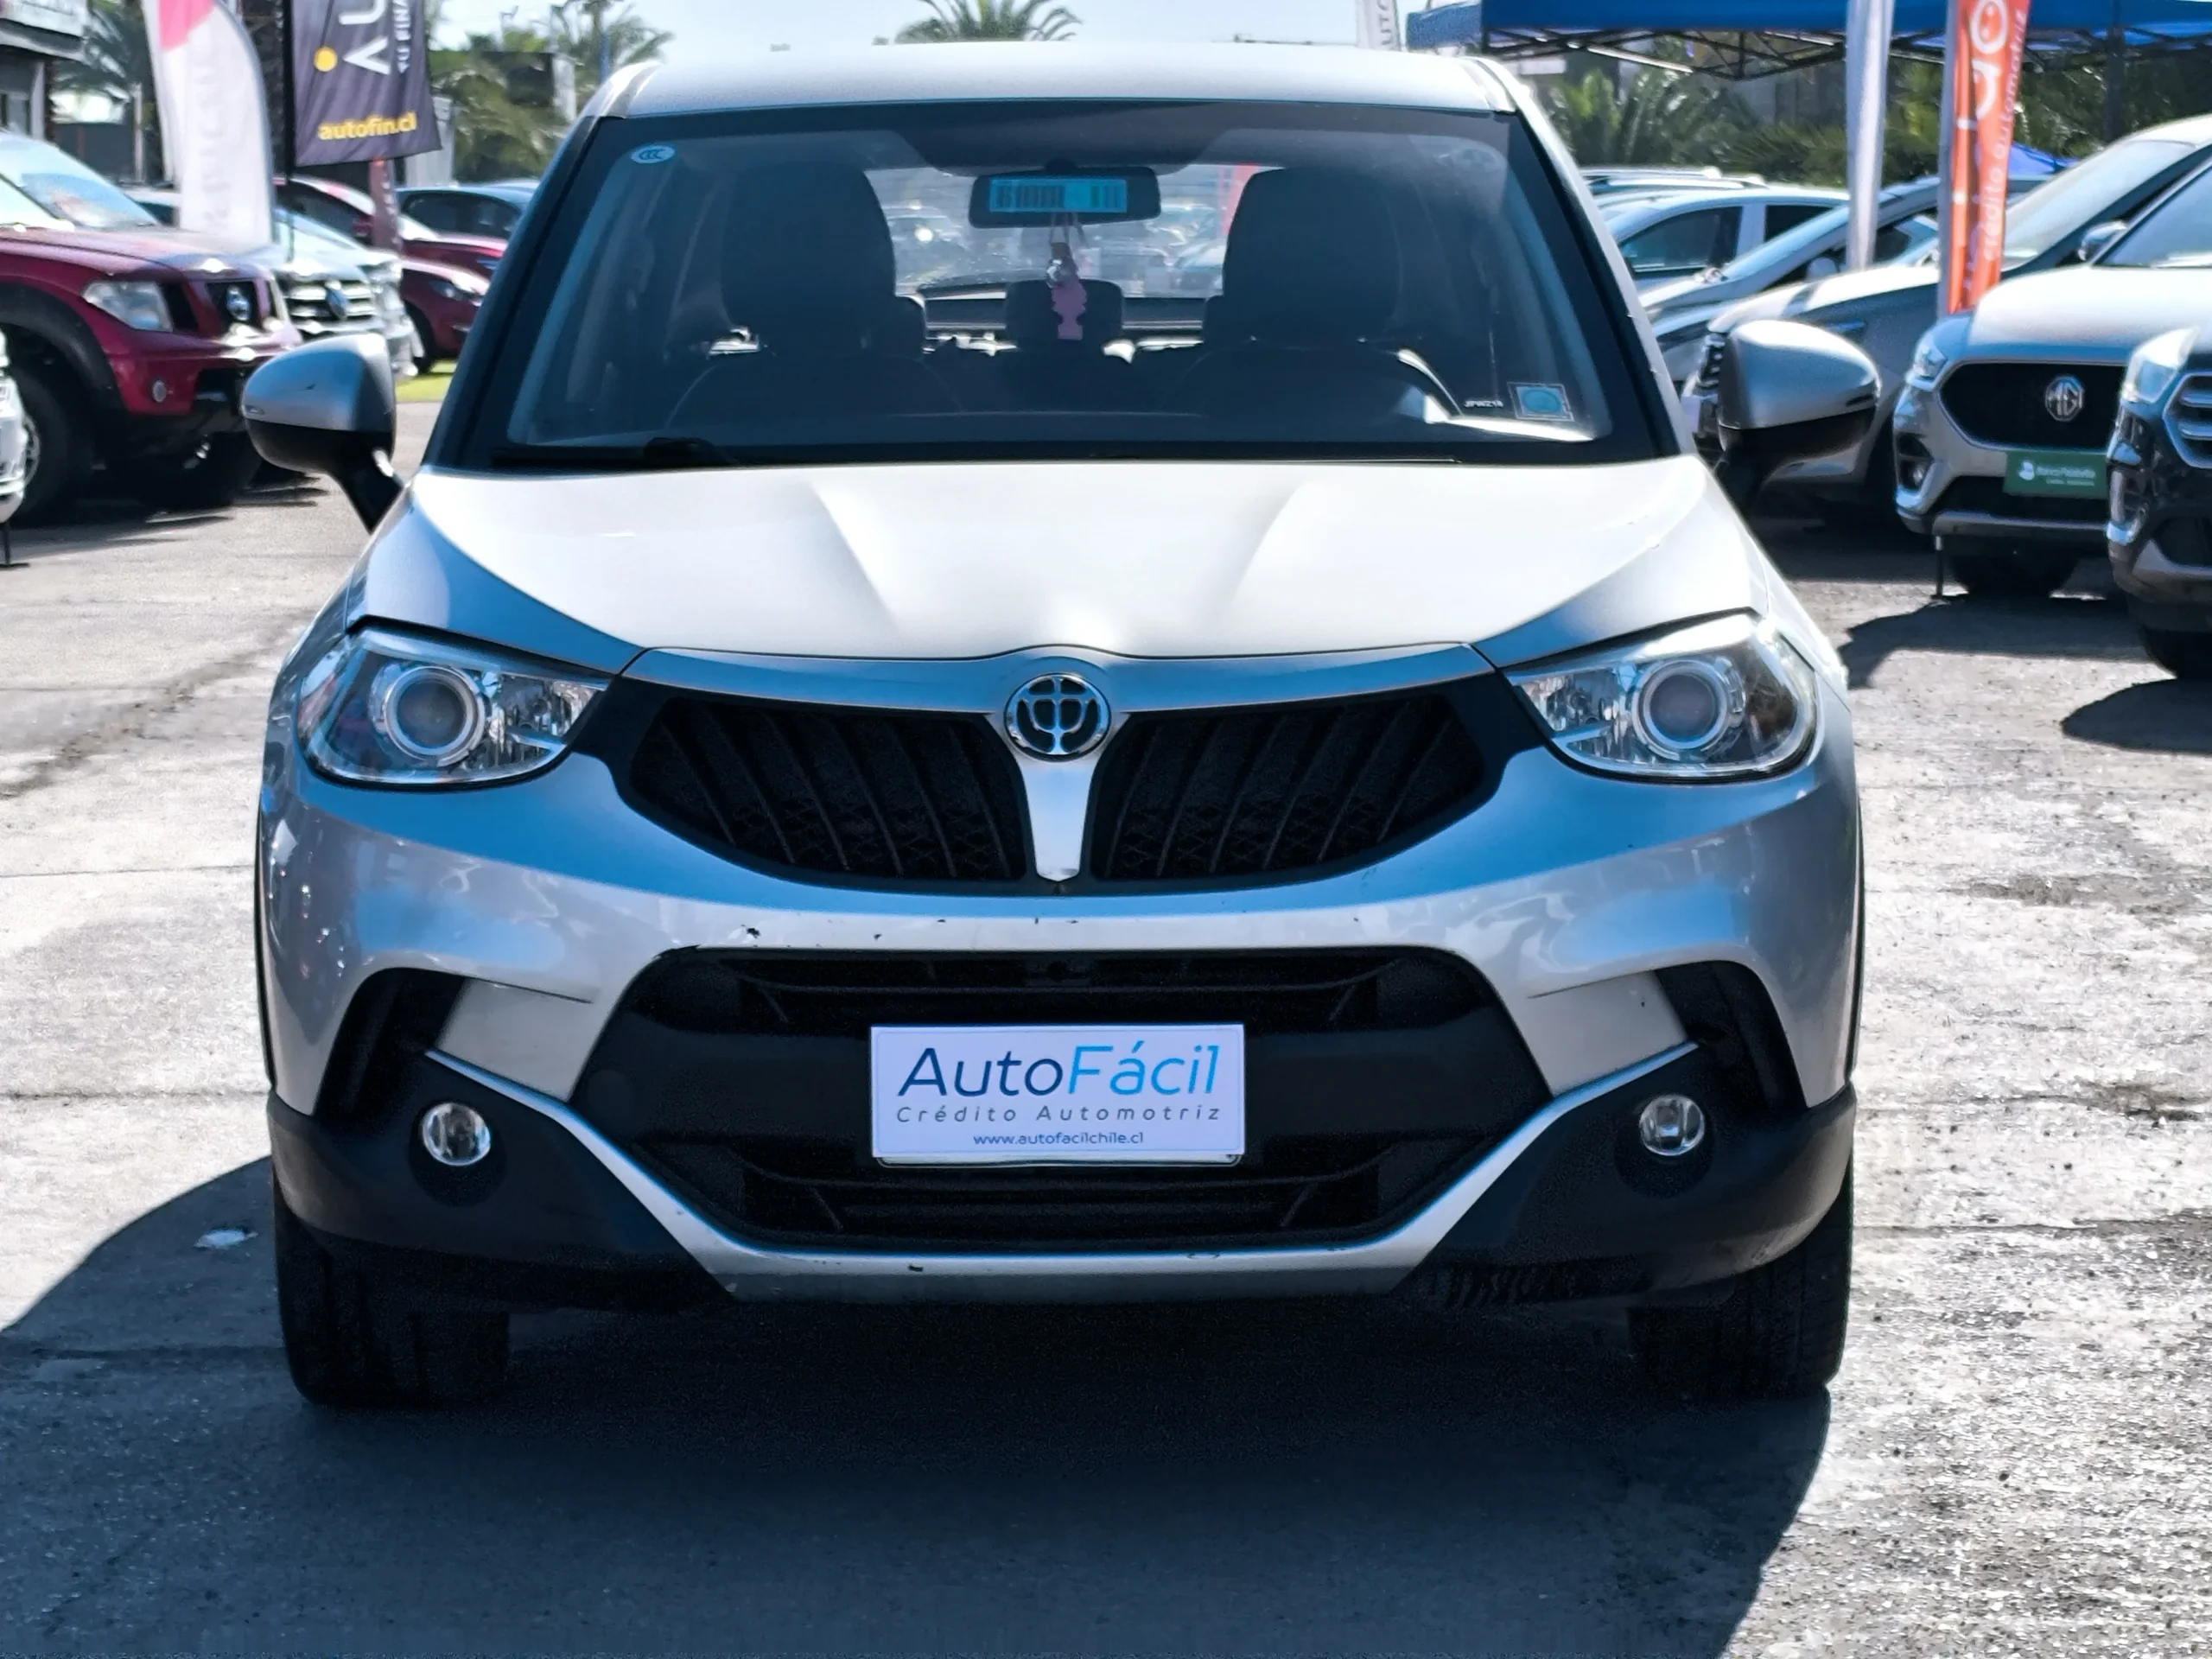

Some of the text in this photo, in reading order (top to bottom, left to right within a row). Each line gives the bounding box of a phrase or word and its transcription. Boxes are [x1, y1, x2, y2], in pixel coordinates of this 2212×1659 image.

[318, 111, 417, 140] autofin.cl
[2046, 380, 2082, 416] MG
[897, 1039, 1220, 1097] AutoFácil
[896, 1104, 1221, 1123] Crédito Automotriz
[973, 1131, 1144, 1146] www.autofacilchile.cl
